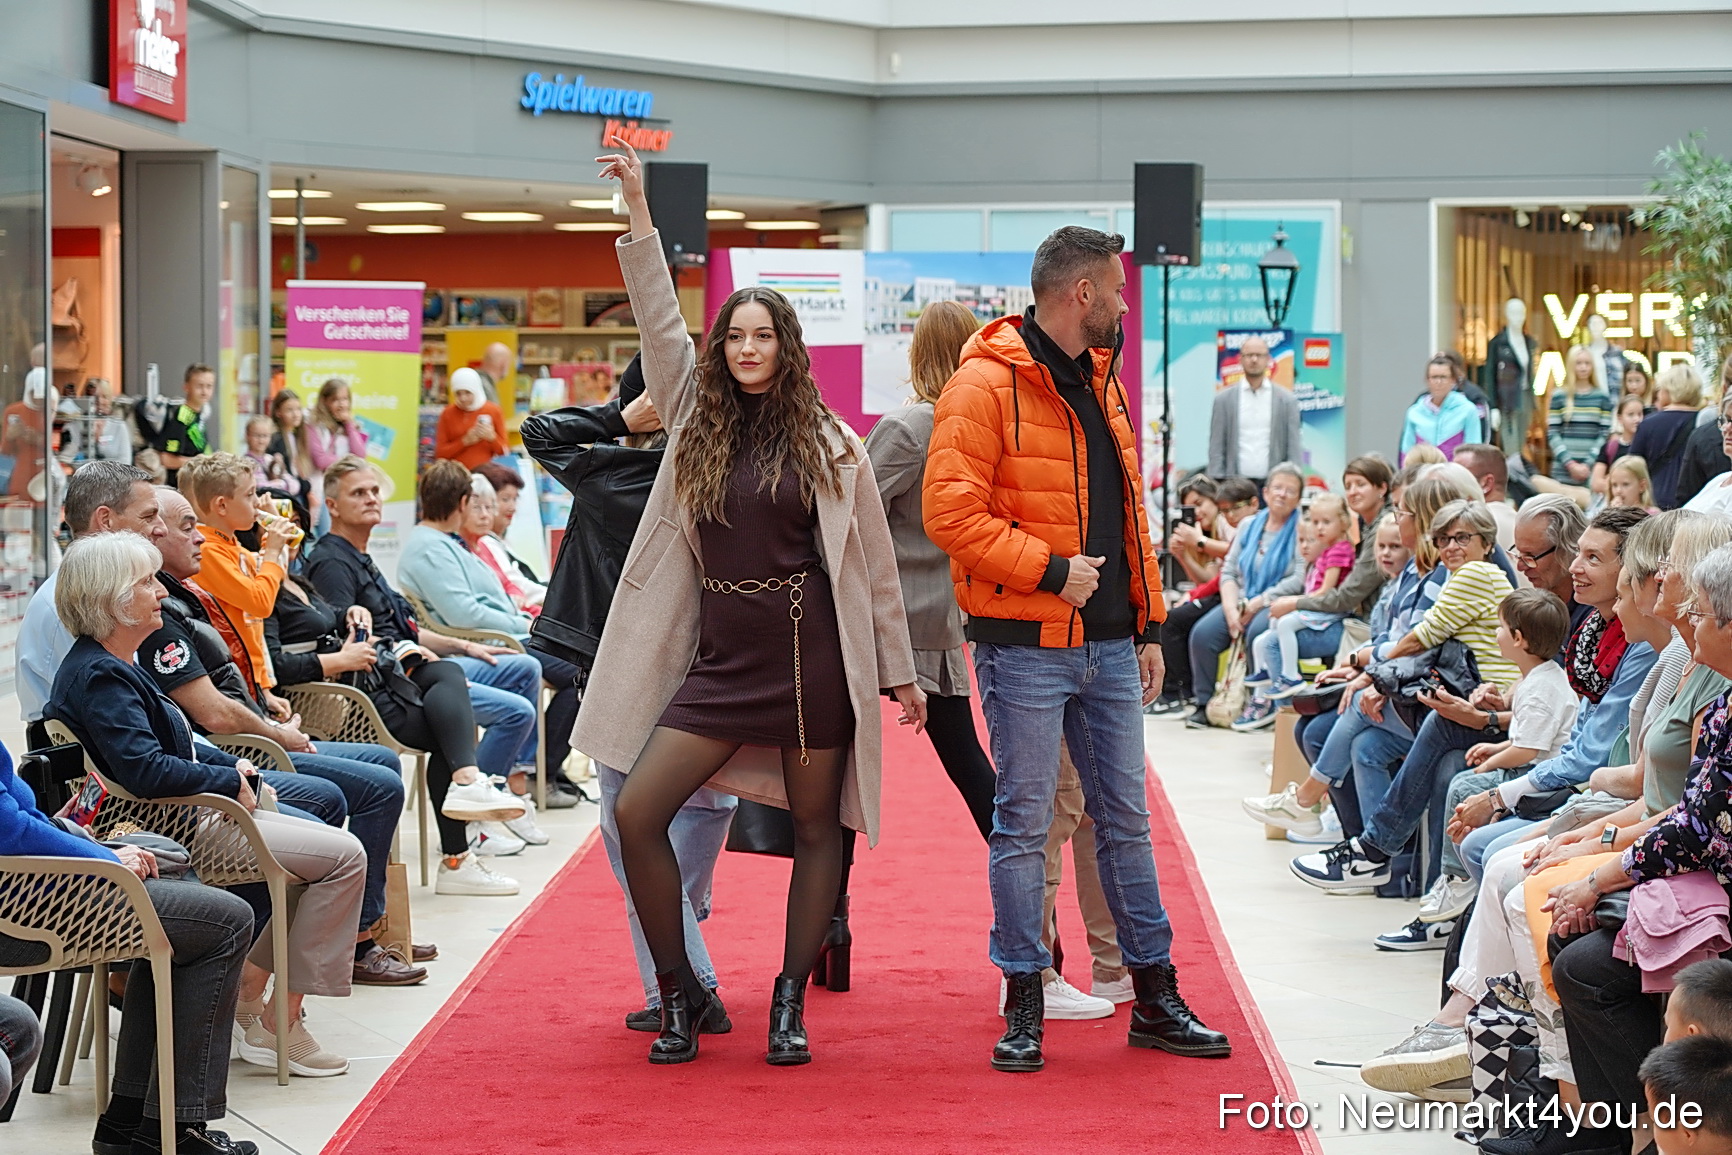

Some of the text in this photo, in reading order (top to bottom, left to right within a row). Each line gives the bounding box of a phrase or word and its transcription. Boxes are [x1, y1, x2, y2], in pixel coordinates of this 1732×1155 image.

[521, 72, 654, 116] Spielwaren
[602, 119, 673, 152] Krömer
[294, 305, 410, 322] Verschenken Sie
[323, 323, 410, 340] Gutscheine!
[1306, 347, 1330, 360] LEGO
